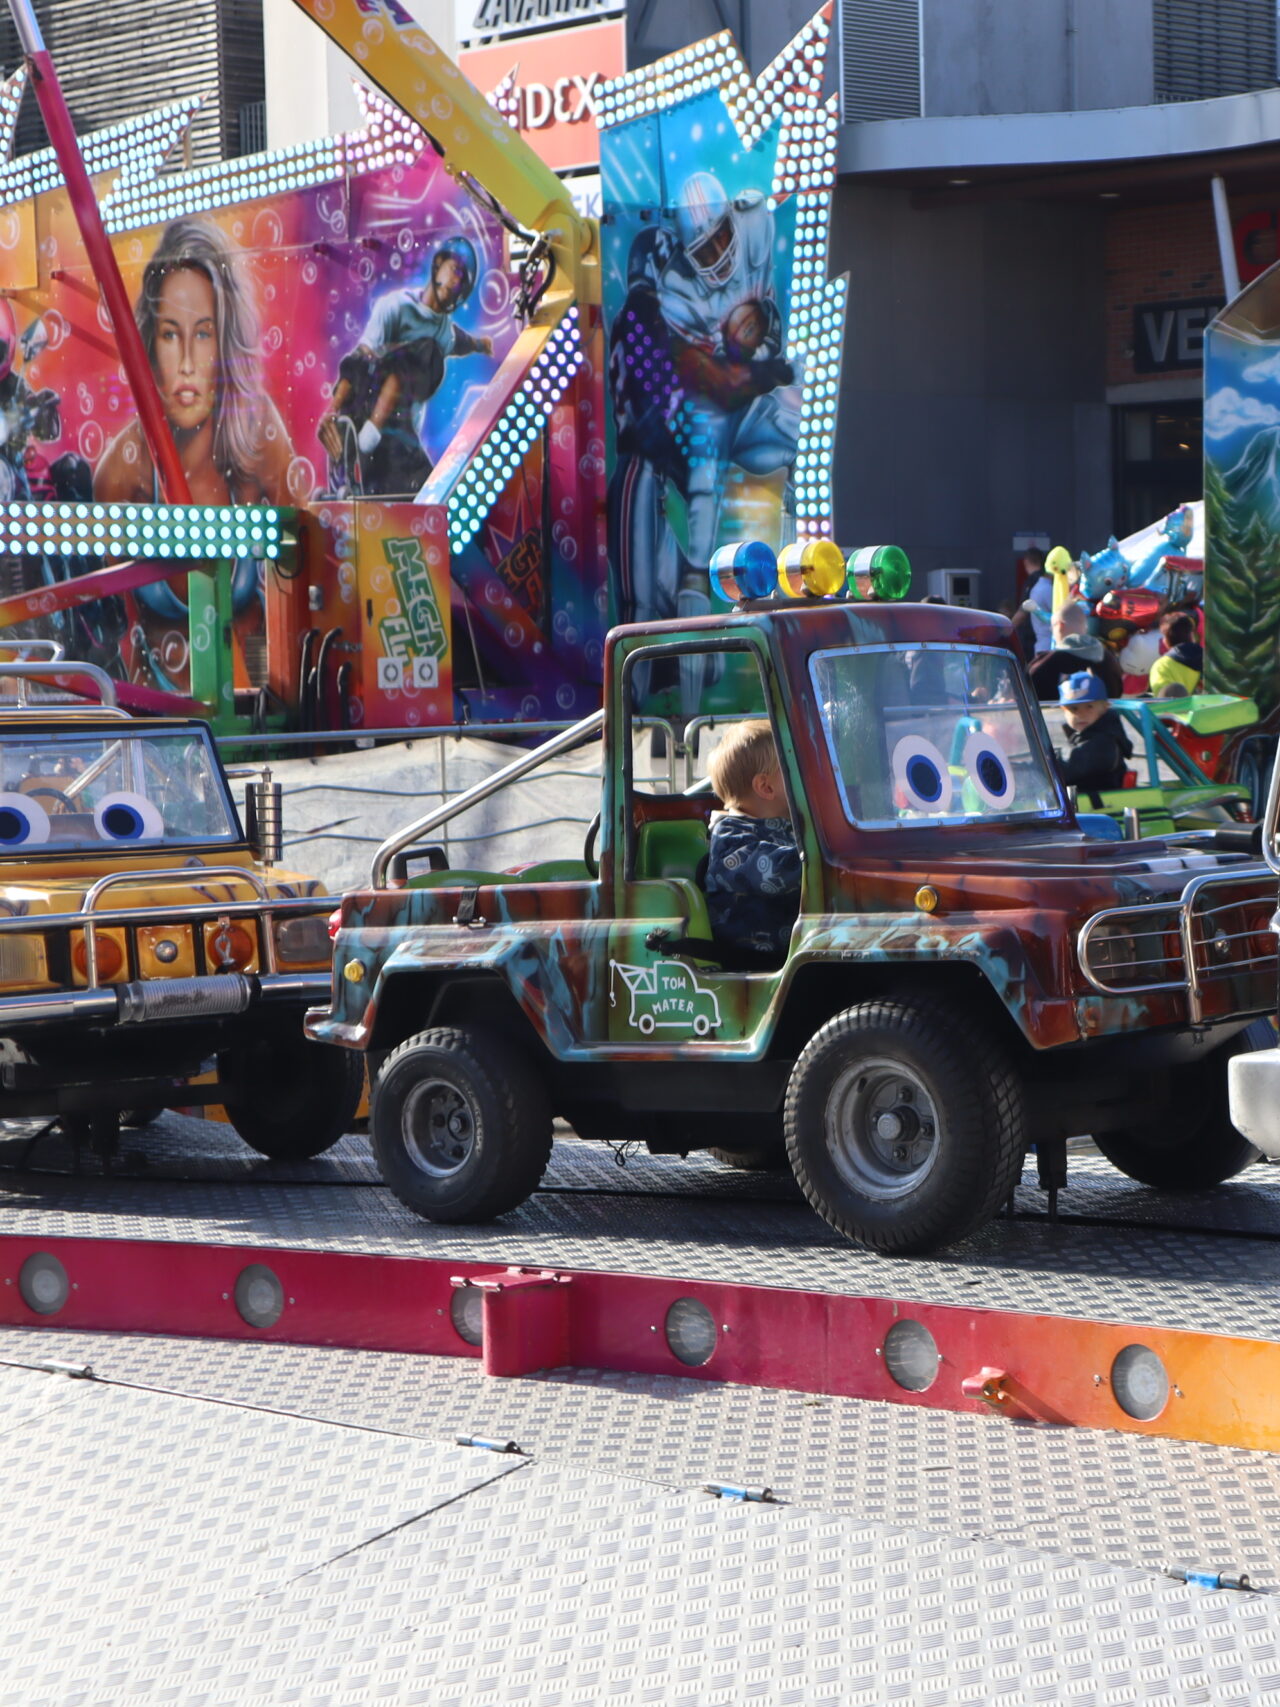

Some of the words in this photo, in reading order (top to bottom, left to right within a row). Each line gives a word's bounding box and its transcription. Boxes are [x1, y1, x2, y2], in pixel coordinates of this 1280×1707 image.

[514, 72, 599, 130] DEX
[1142, 306, 1220, 363] VE
[386, 538, 447, 659] MEGA
[651, 998, 695, 1015] MATER
[661, 976, 687, 990] TOW
